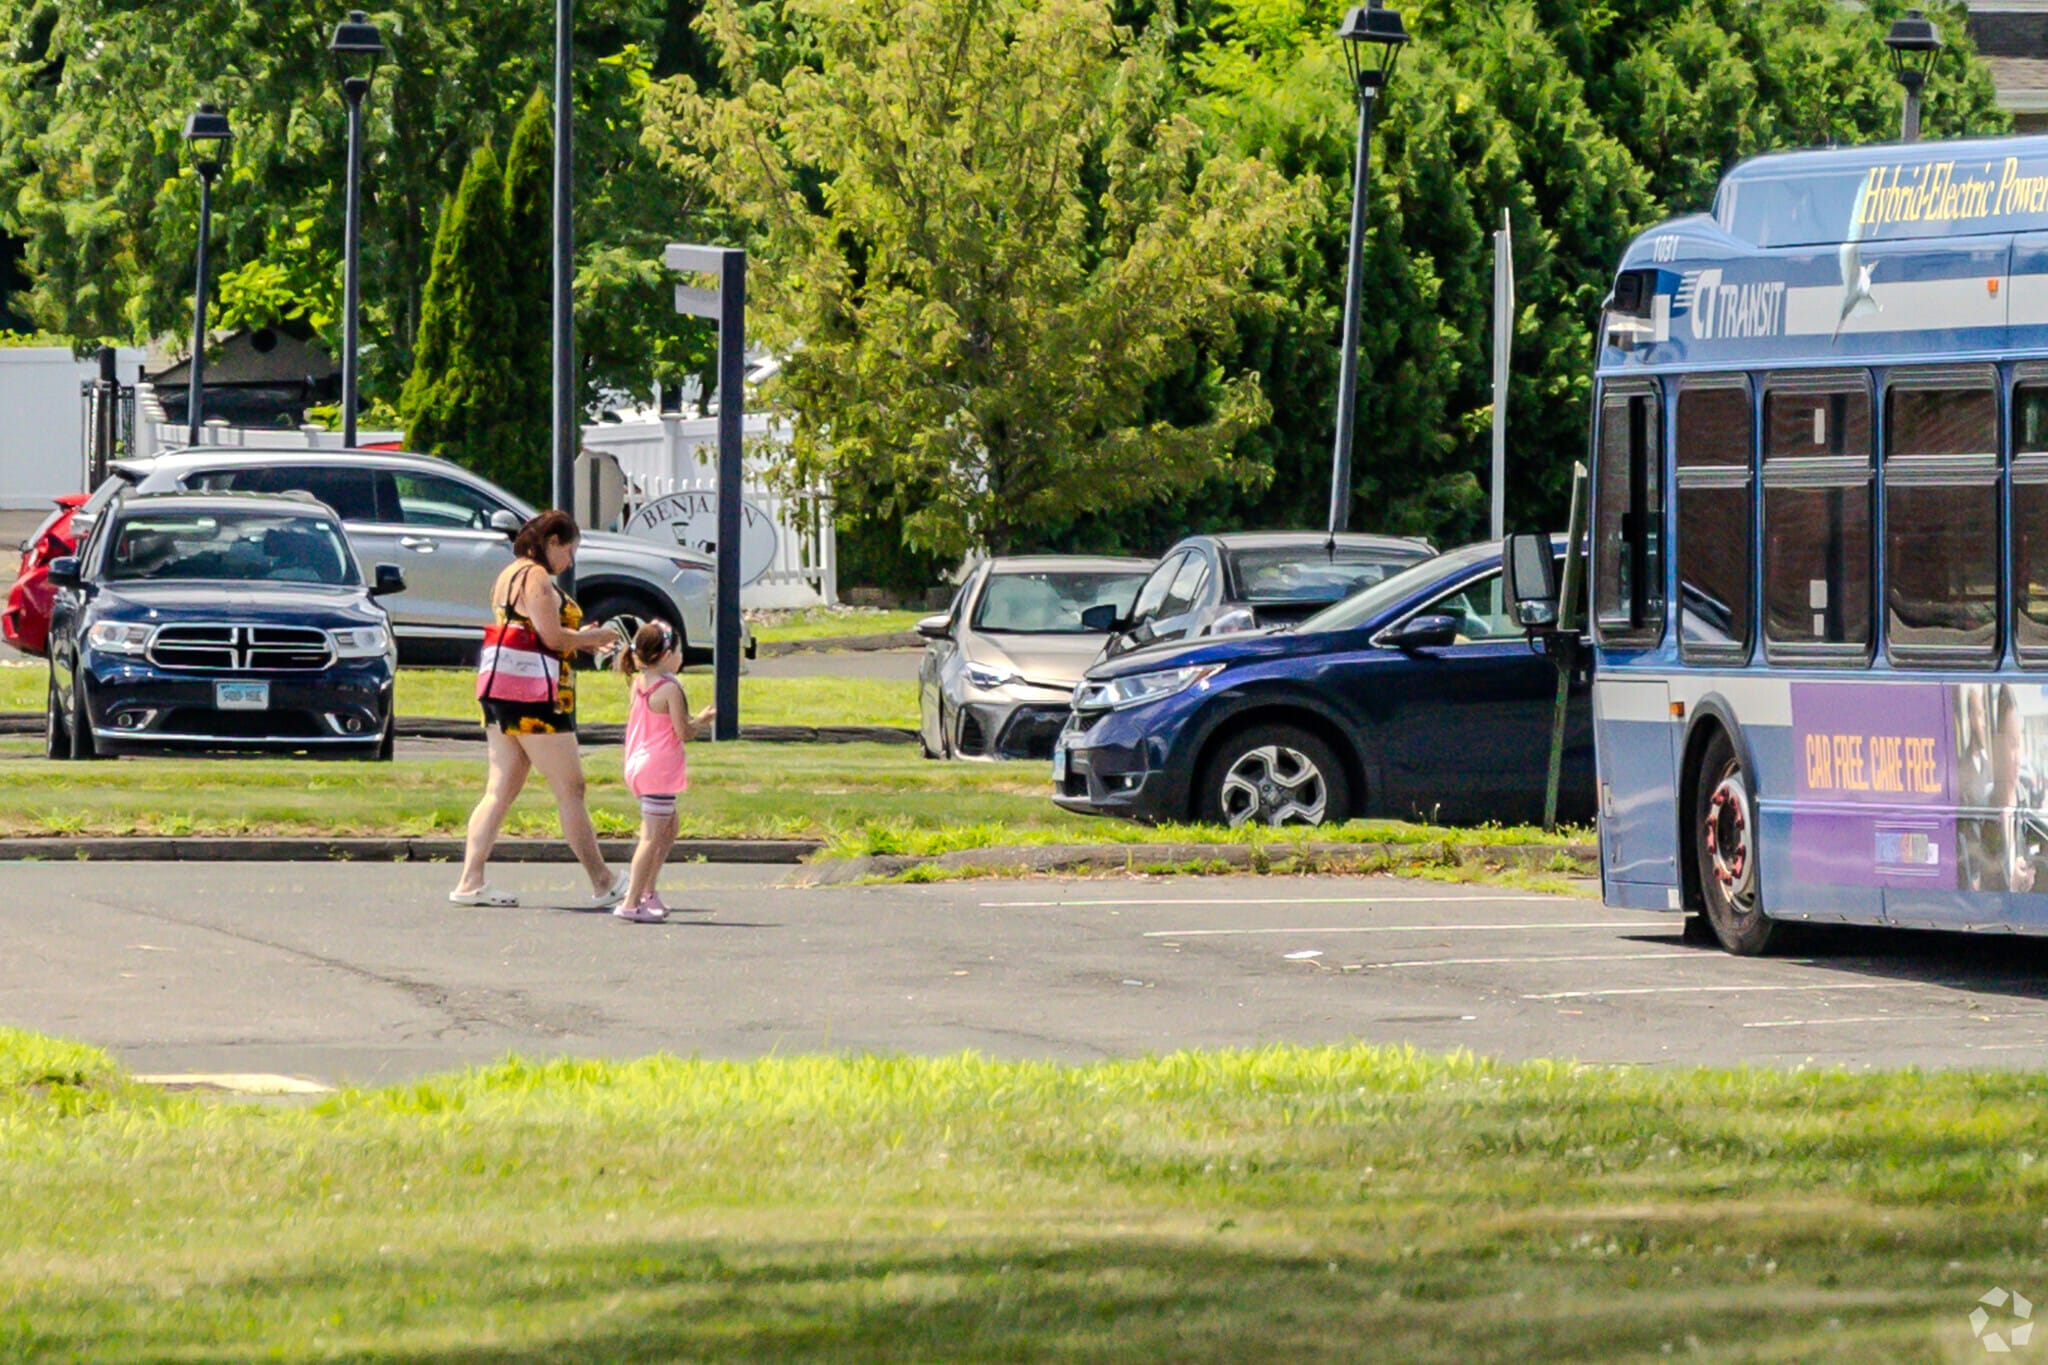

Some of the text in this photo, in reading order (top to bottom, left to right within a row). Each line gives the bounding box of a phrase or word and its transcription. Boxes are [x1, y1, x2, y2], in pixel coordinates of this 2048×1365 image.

[1858, 160, 1996, 236] Hybrid-Electric
[1652, 234, 1681, 263] 1031
[1690, 268, 1786, 340] CT TRANSIT
[642, 495, 759, 529] BENJAN
[1805, 734, 1833, 789] CAR
[1869, 736, 1904, 792] CARE
